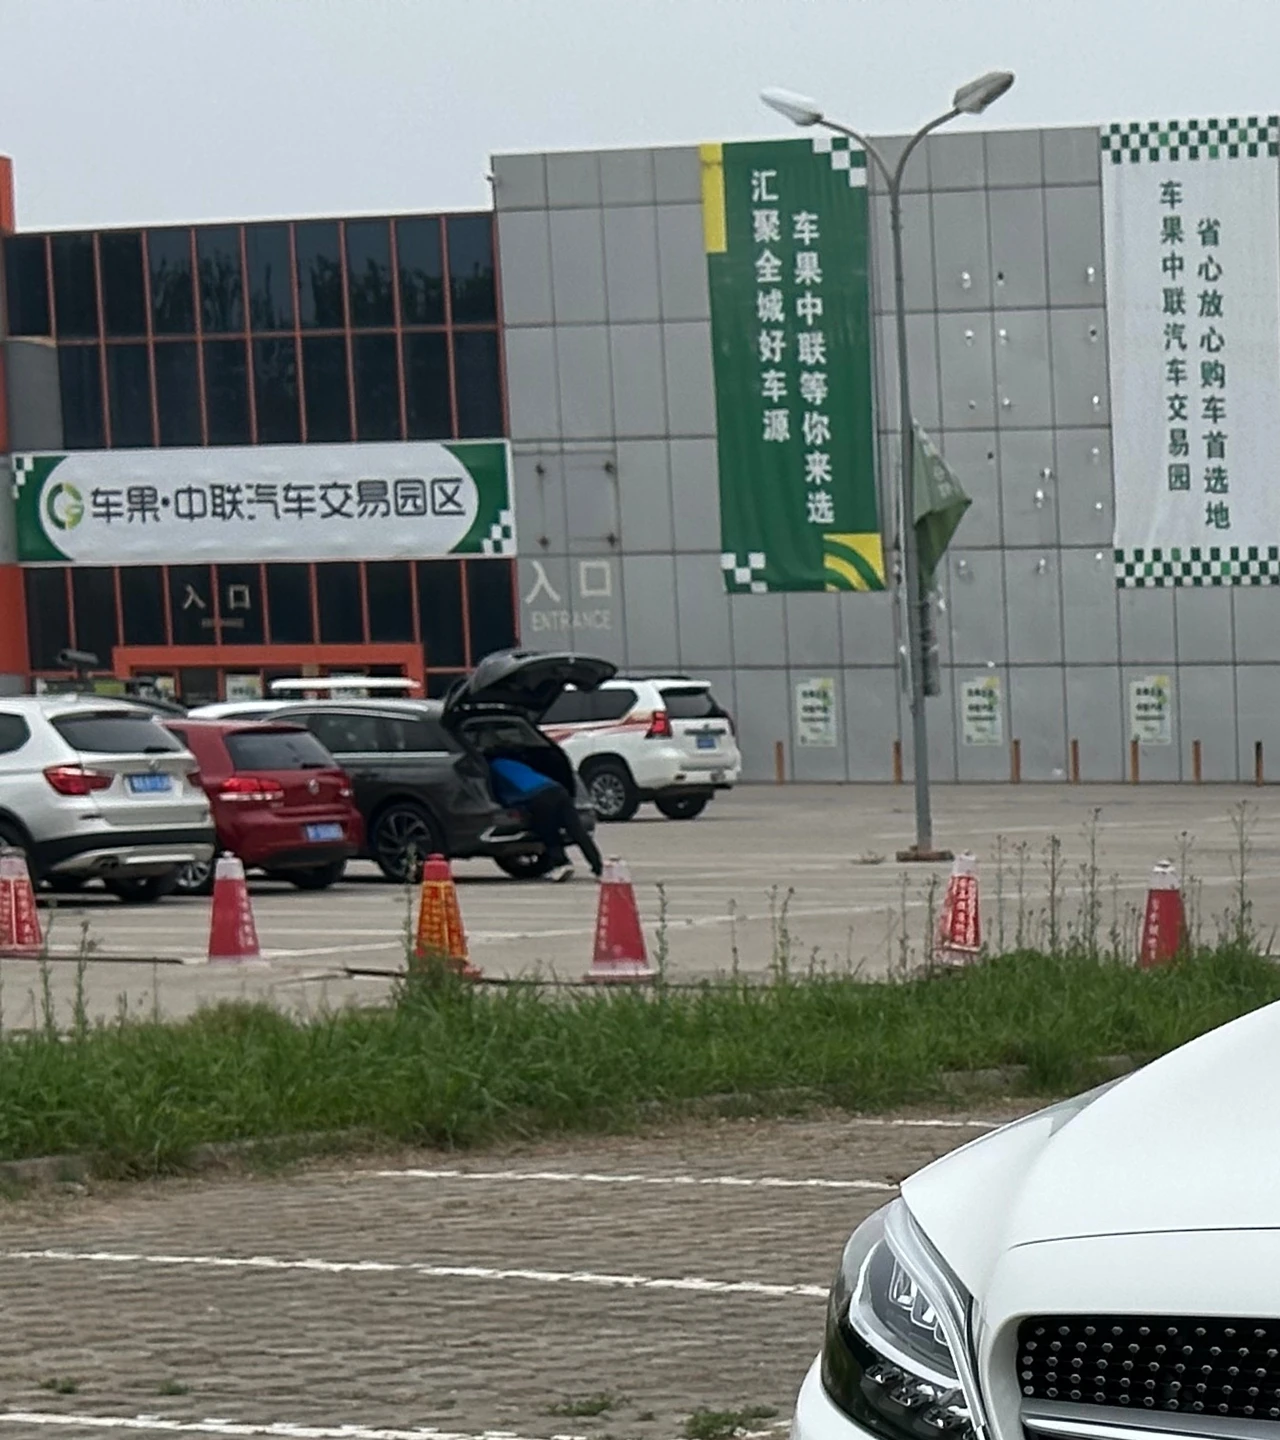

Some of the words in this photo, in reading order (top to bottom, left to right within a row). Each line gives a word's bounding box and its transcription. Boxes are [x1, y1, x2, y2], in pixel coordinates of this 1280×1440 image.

[751, 169, 791, 443] 汇聚全城好车源
[793, 210, 835, 525] 车果中联等你来选
[1159, 179, 1192, 492] 车果中联汽车交易园
[1197, 218, 1231, 531] 省心放心购车首选地
[90, 476, 467, 525] 车果·中联汽车交易园区
[182, 584, 252, 610] 入口
[524, 559, 612, 605] 入口
[530, 609, 614, 631] ENTRANCE
